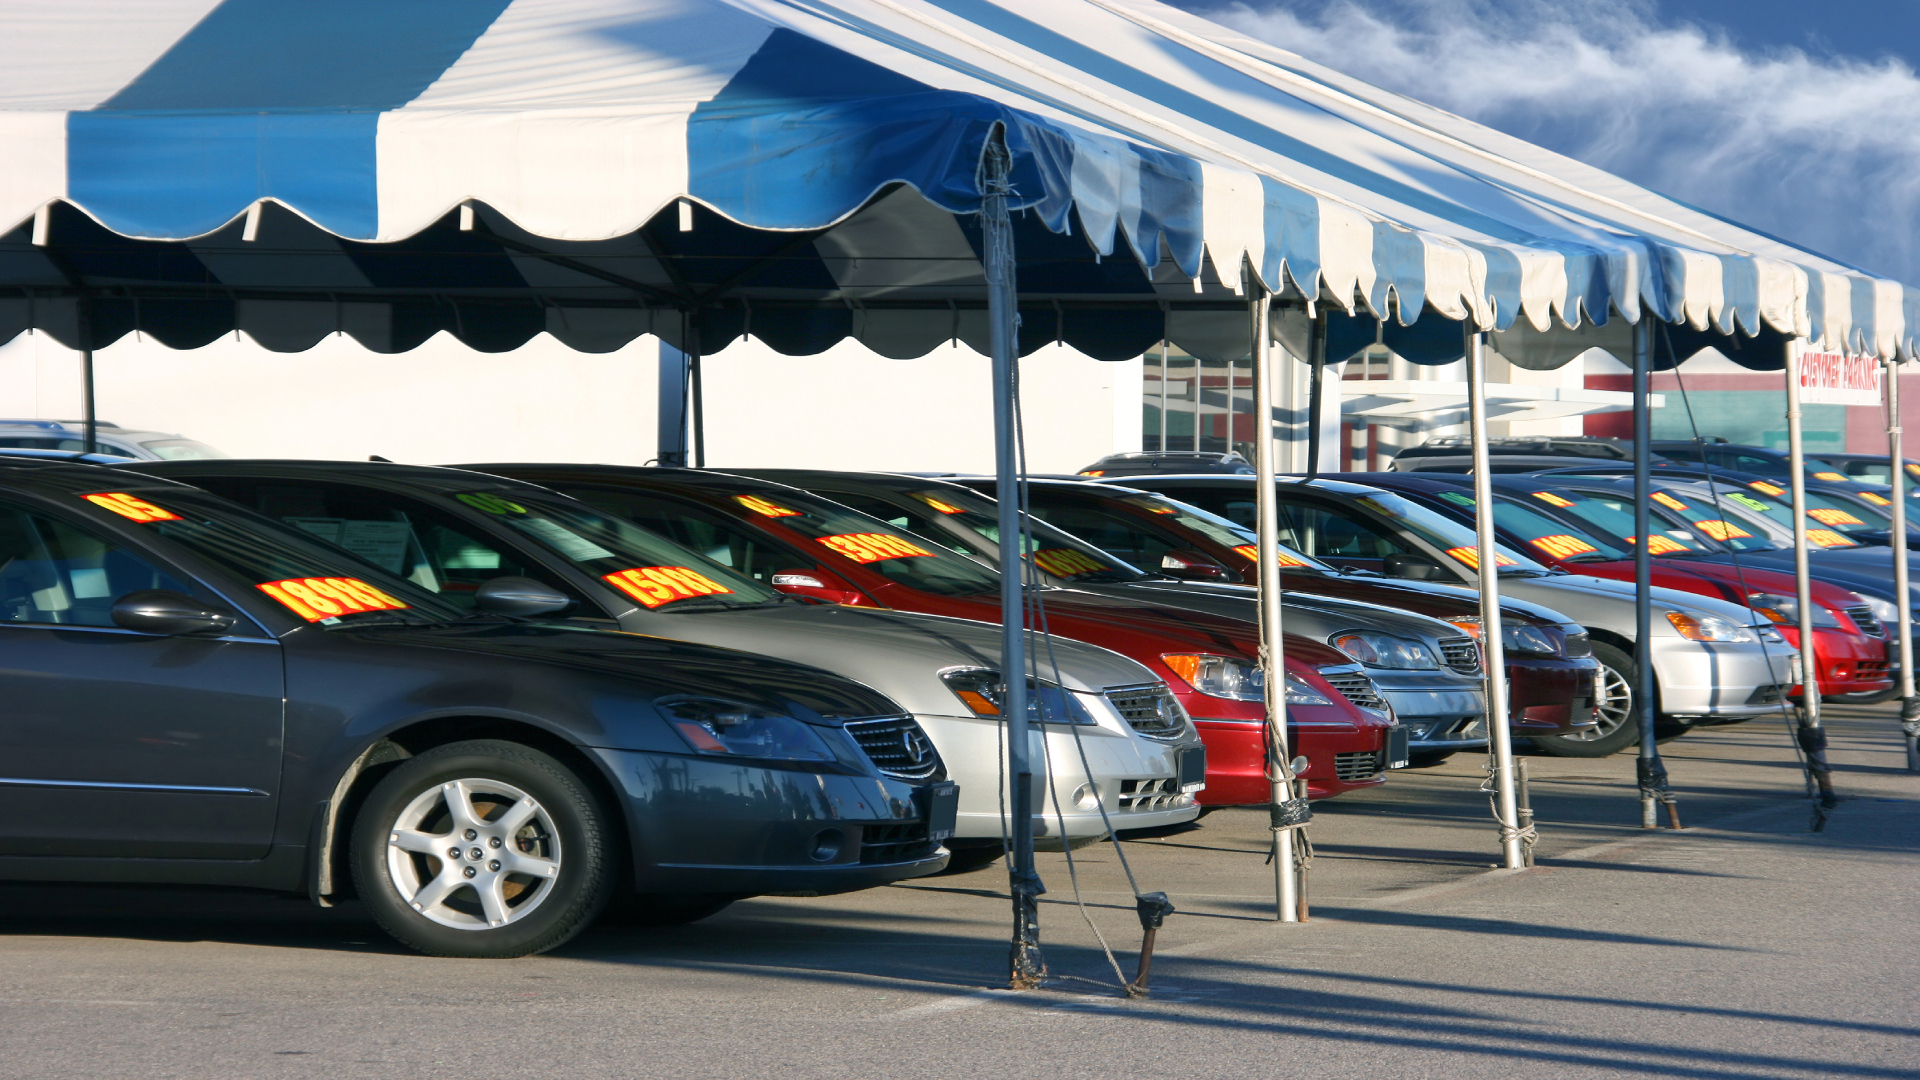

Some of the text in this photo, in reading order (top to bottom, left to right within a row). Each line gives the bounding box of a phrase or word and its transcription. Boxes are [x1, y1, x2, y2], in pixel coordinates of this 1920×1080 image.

[86, 493, 173, 520] 05
[455, 492, 527, 514] 06
[1725, 493, 1771, 511] 05
[820, 533, 932, 562] $31988
[261, 578, 407, 620] 18988
[606, 567, 729, 605] 15988
